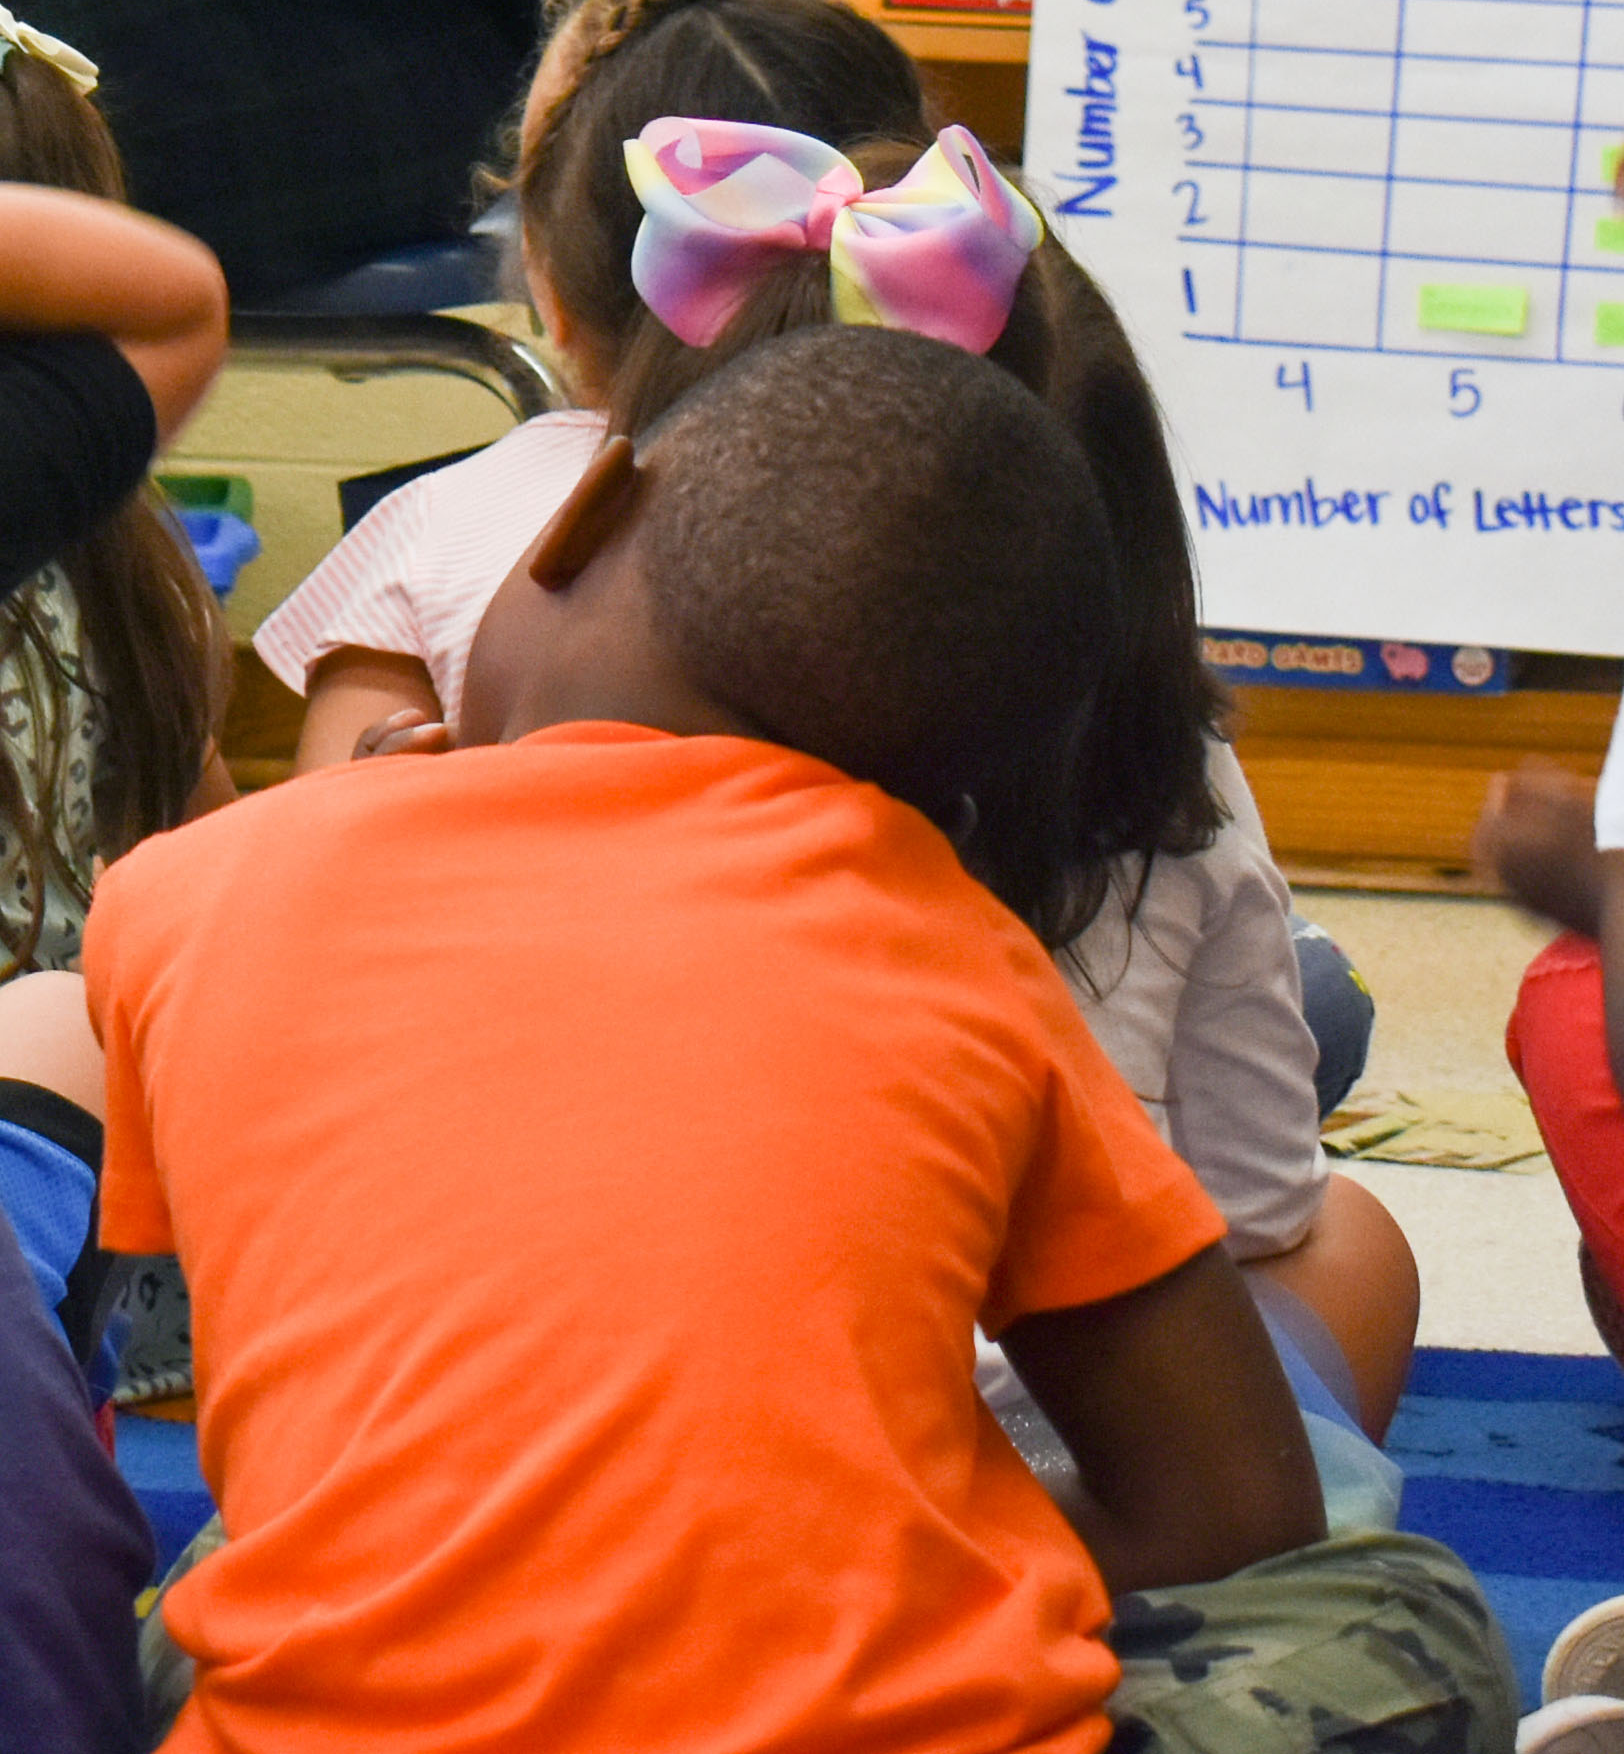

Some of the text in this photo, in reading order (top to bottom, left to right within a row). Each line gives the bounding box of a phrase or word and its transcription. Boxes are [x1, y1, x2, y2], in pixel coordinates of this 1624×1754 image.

[1175, 53, 1205, 90] 4
[1052, 28, 1122, 219] Number
[1175, 112, 1206, 151] 3
[1171, 179, 1209, 227] 2
[1181, 266, 1198, 315] 1
[1274, 359, 1483, 419] 4 5
[1194, 476, 1624, 533] Number of Letters
